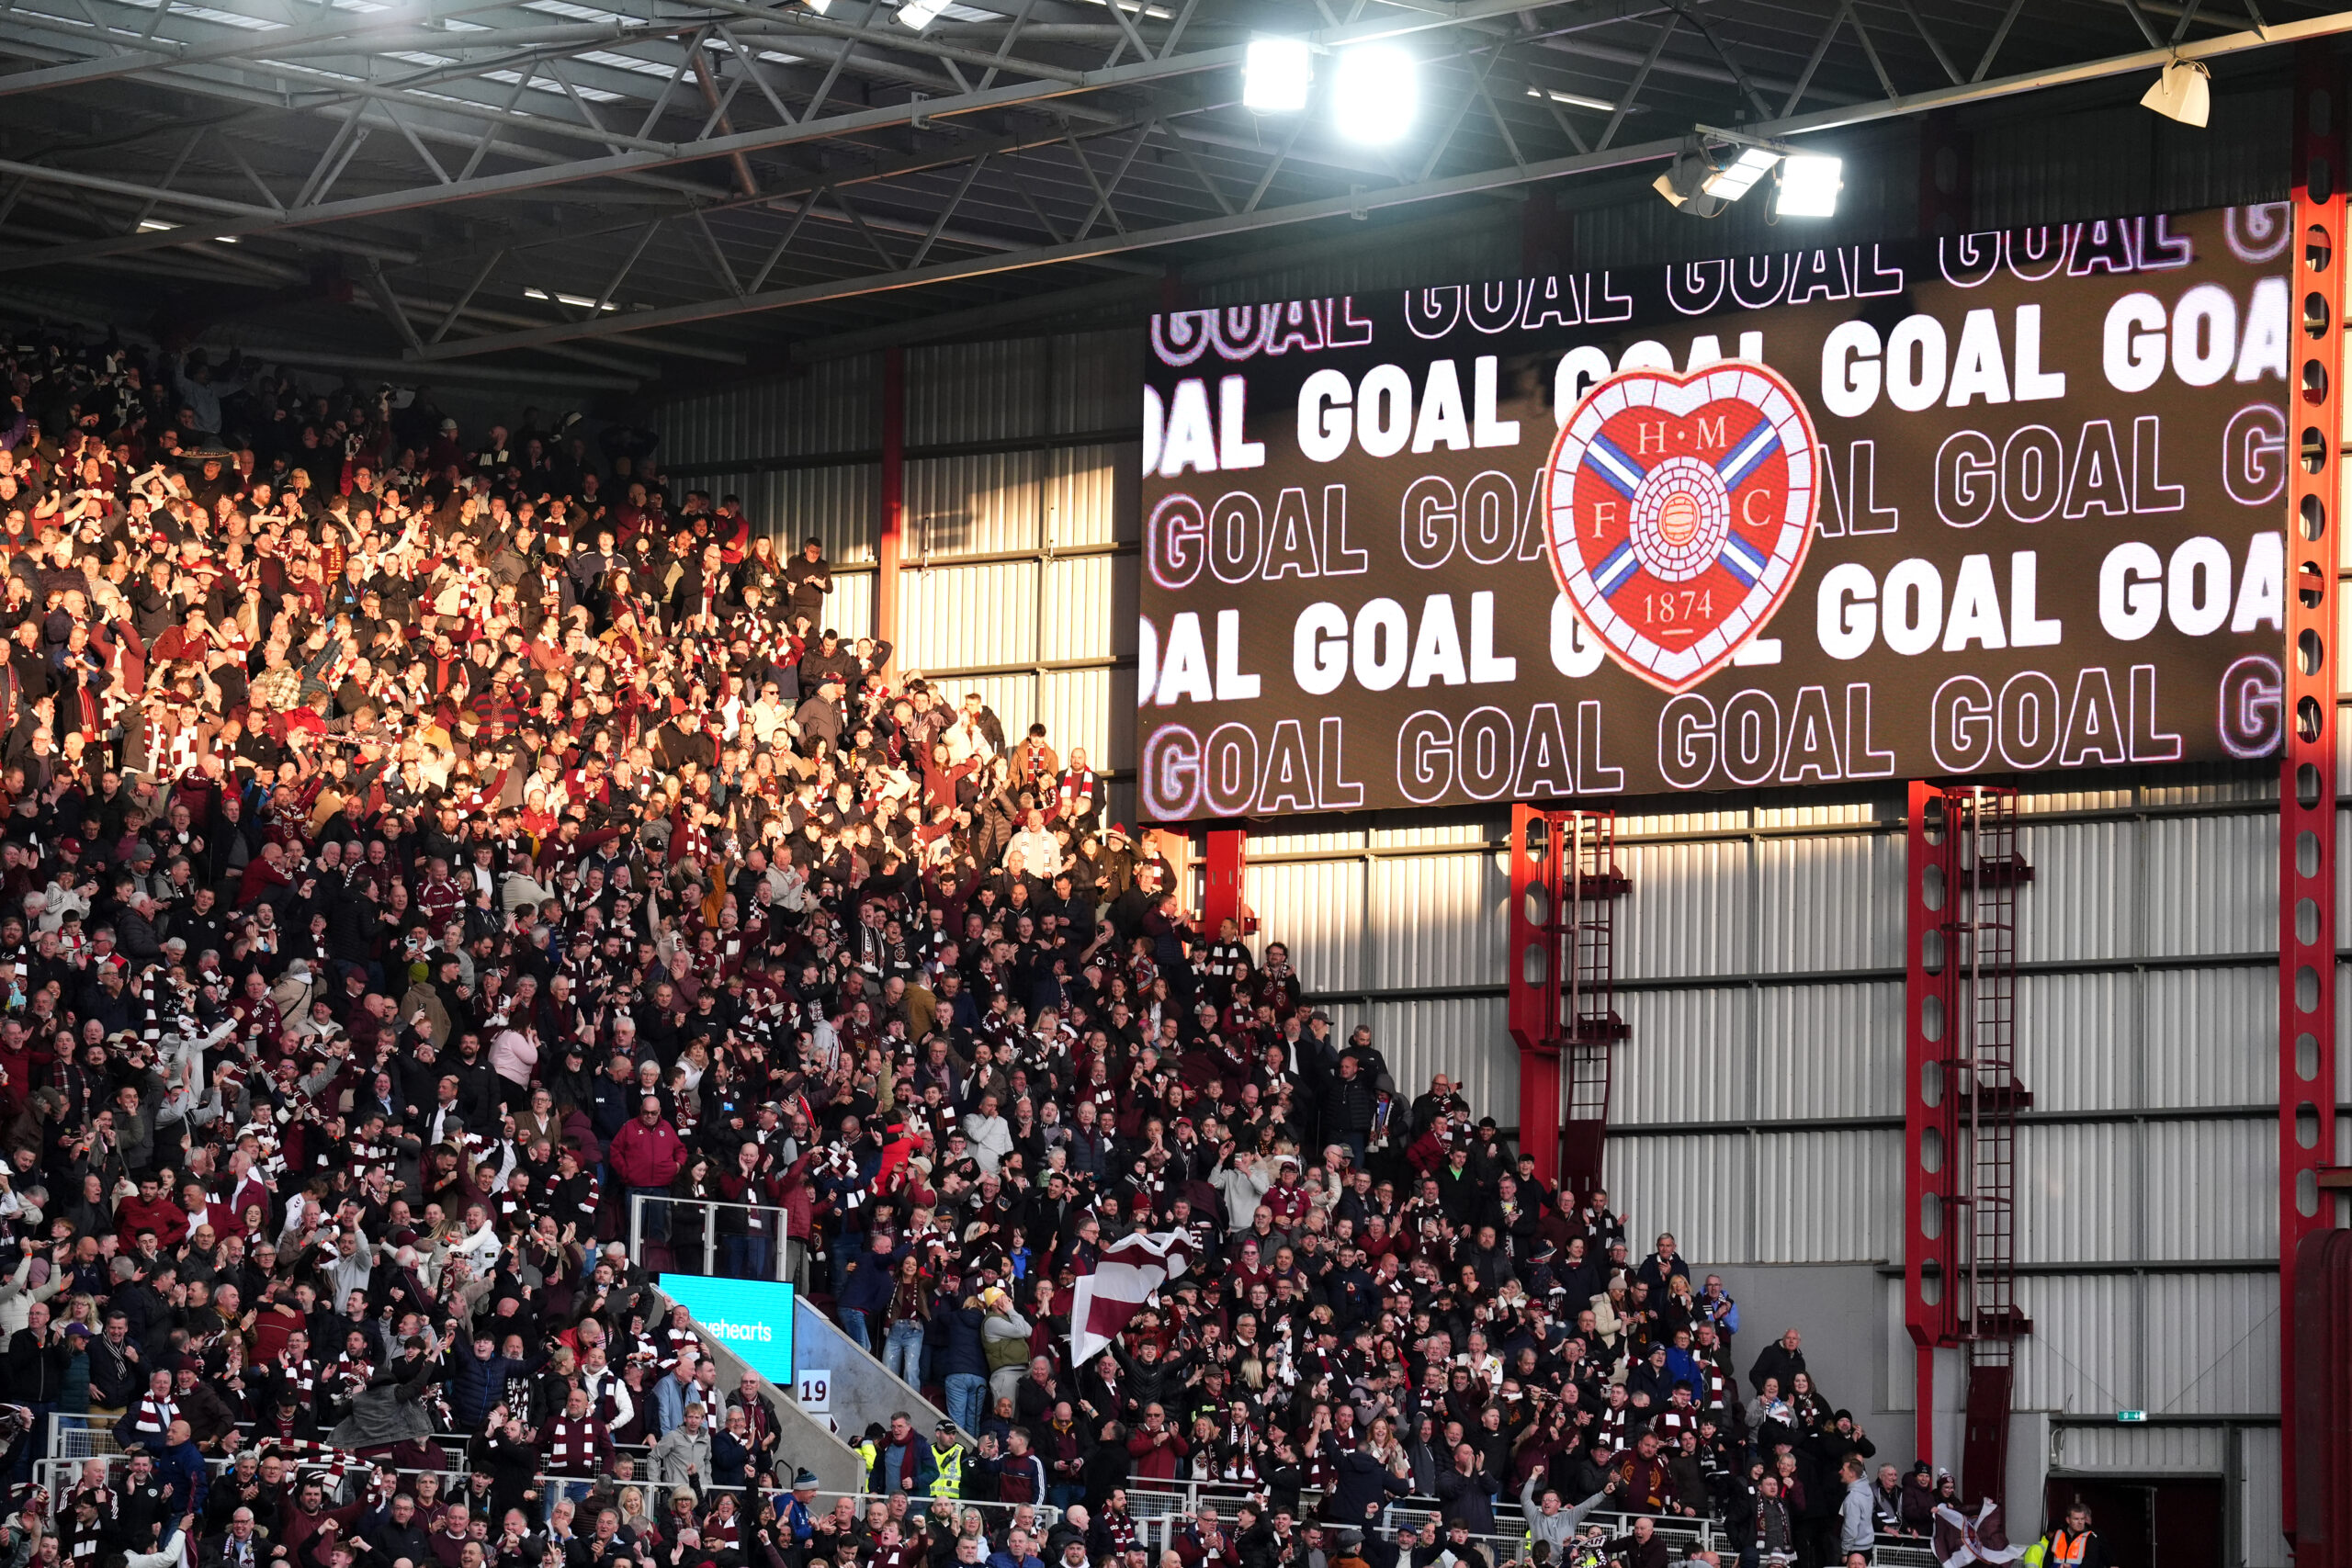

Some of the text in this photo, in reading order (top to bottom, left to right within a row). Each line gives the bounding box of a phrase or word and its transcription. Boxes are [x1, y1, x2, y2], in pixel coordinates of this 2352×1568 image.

[1151, 297, 1373, 367] GOAL
[1405, 270, 1633, 340] GOAL
[1666, 243, 1904, 316] GOAL
[1939, 215, 2191, 288] GOAL
[1296, 355, 1521, 463] GOAL
[1821, 303, 2066, 418] GOAL
[1148, 483, 1369, 589] GOAL
[1935, 415, 2185, 528] GOAL
[1293, 590, 1517, 695] GOAL
[1816, 549, 2063, 660] GOAL
[1643, 589, 1714, 625] 1874
[1143, 716, 1364, 821] GOAL
[1396, 699, 1624, 804] GOAL
[1657, 682, 1895, 789] GOAL
[1930, 663, 2182, 773] GOAL
[801, 1380, 827, 1402] 19
